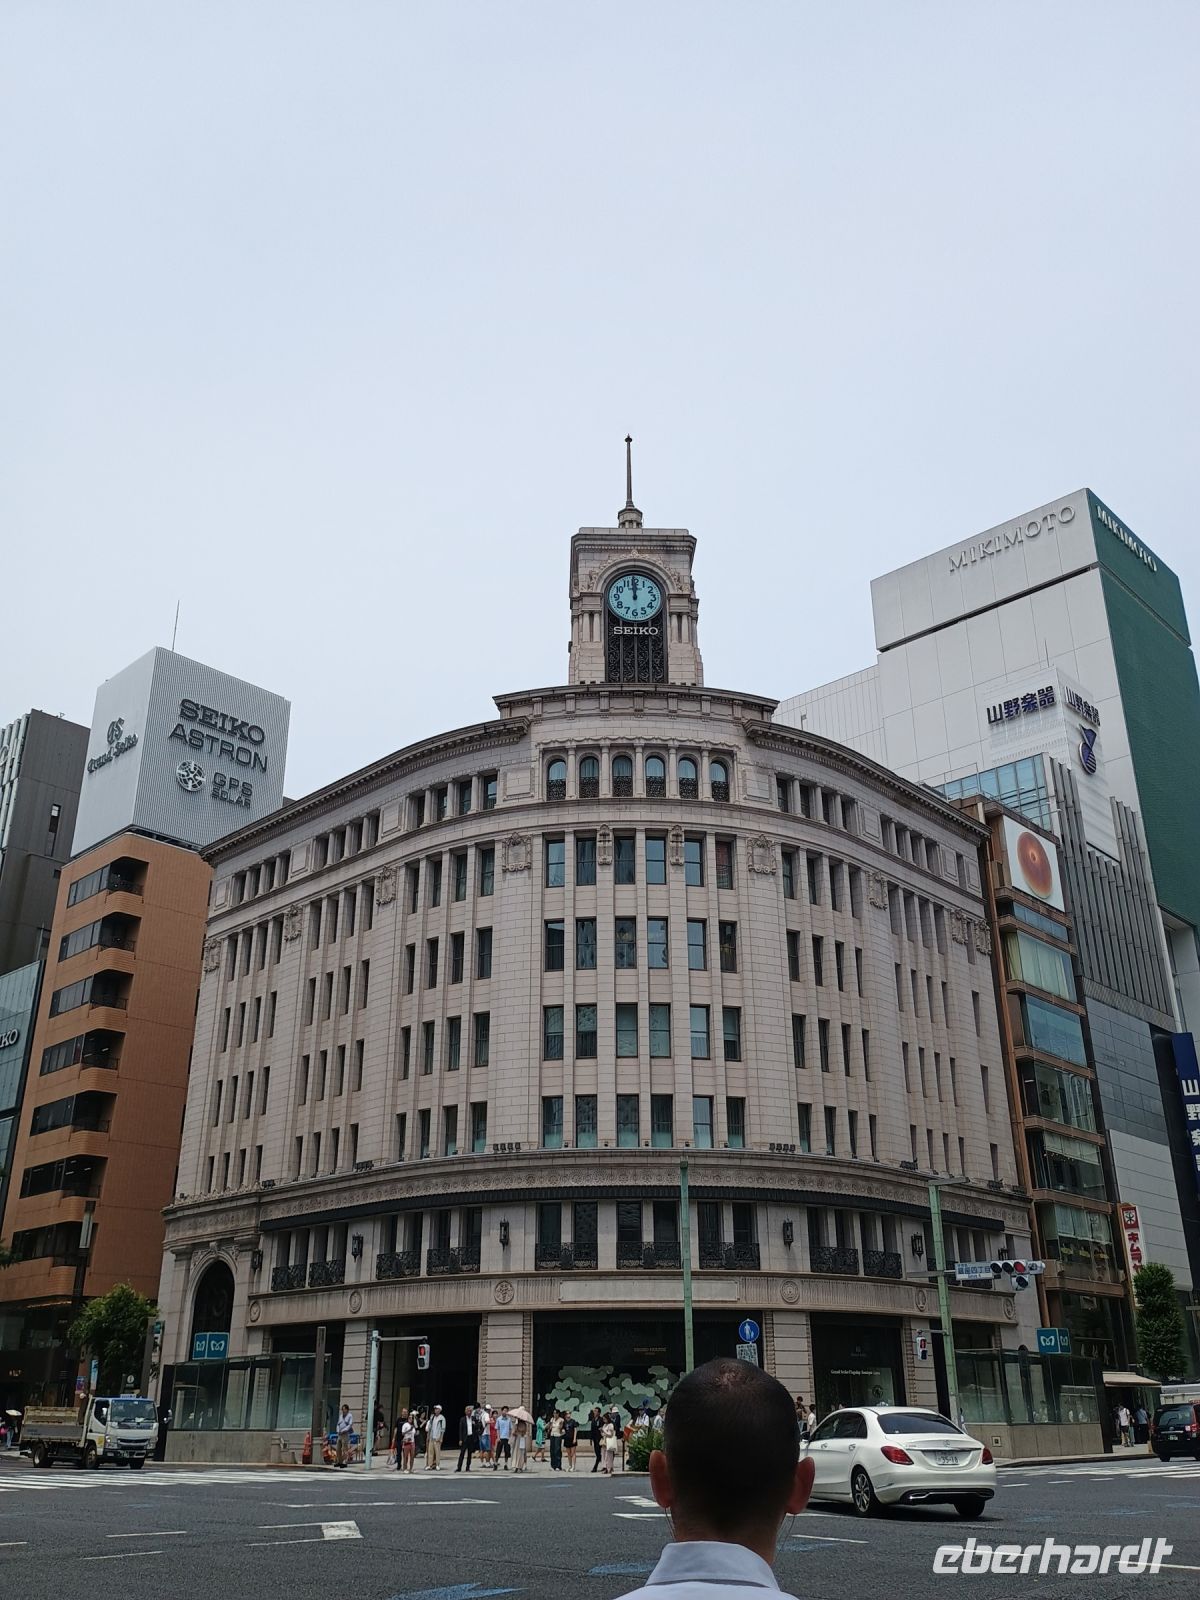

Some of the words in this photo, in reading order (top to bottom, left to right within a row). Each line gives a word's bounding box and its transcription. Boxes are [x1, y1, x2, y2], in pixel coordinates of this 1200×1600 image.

[949, 505, 1075, 572] MIKIMOTO
[1096, 505, 1158, 572] MIKIMOTO
[617, 601, 623, 609] 8
[650, 594, 656, 602] 3
[641, 607, 647, 615] 5
[613, 626, 658, 635] SEIKO
[986, 685, 1055, 724] 山野楽器
[179, 698, 265, 745] SEIKO
[168, 723, 268, 773] ASTRON
[213, 772, 253, 797] GPS
[211, 786, 251, 809] SOLAR
